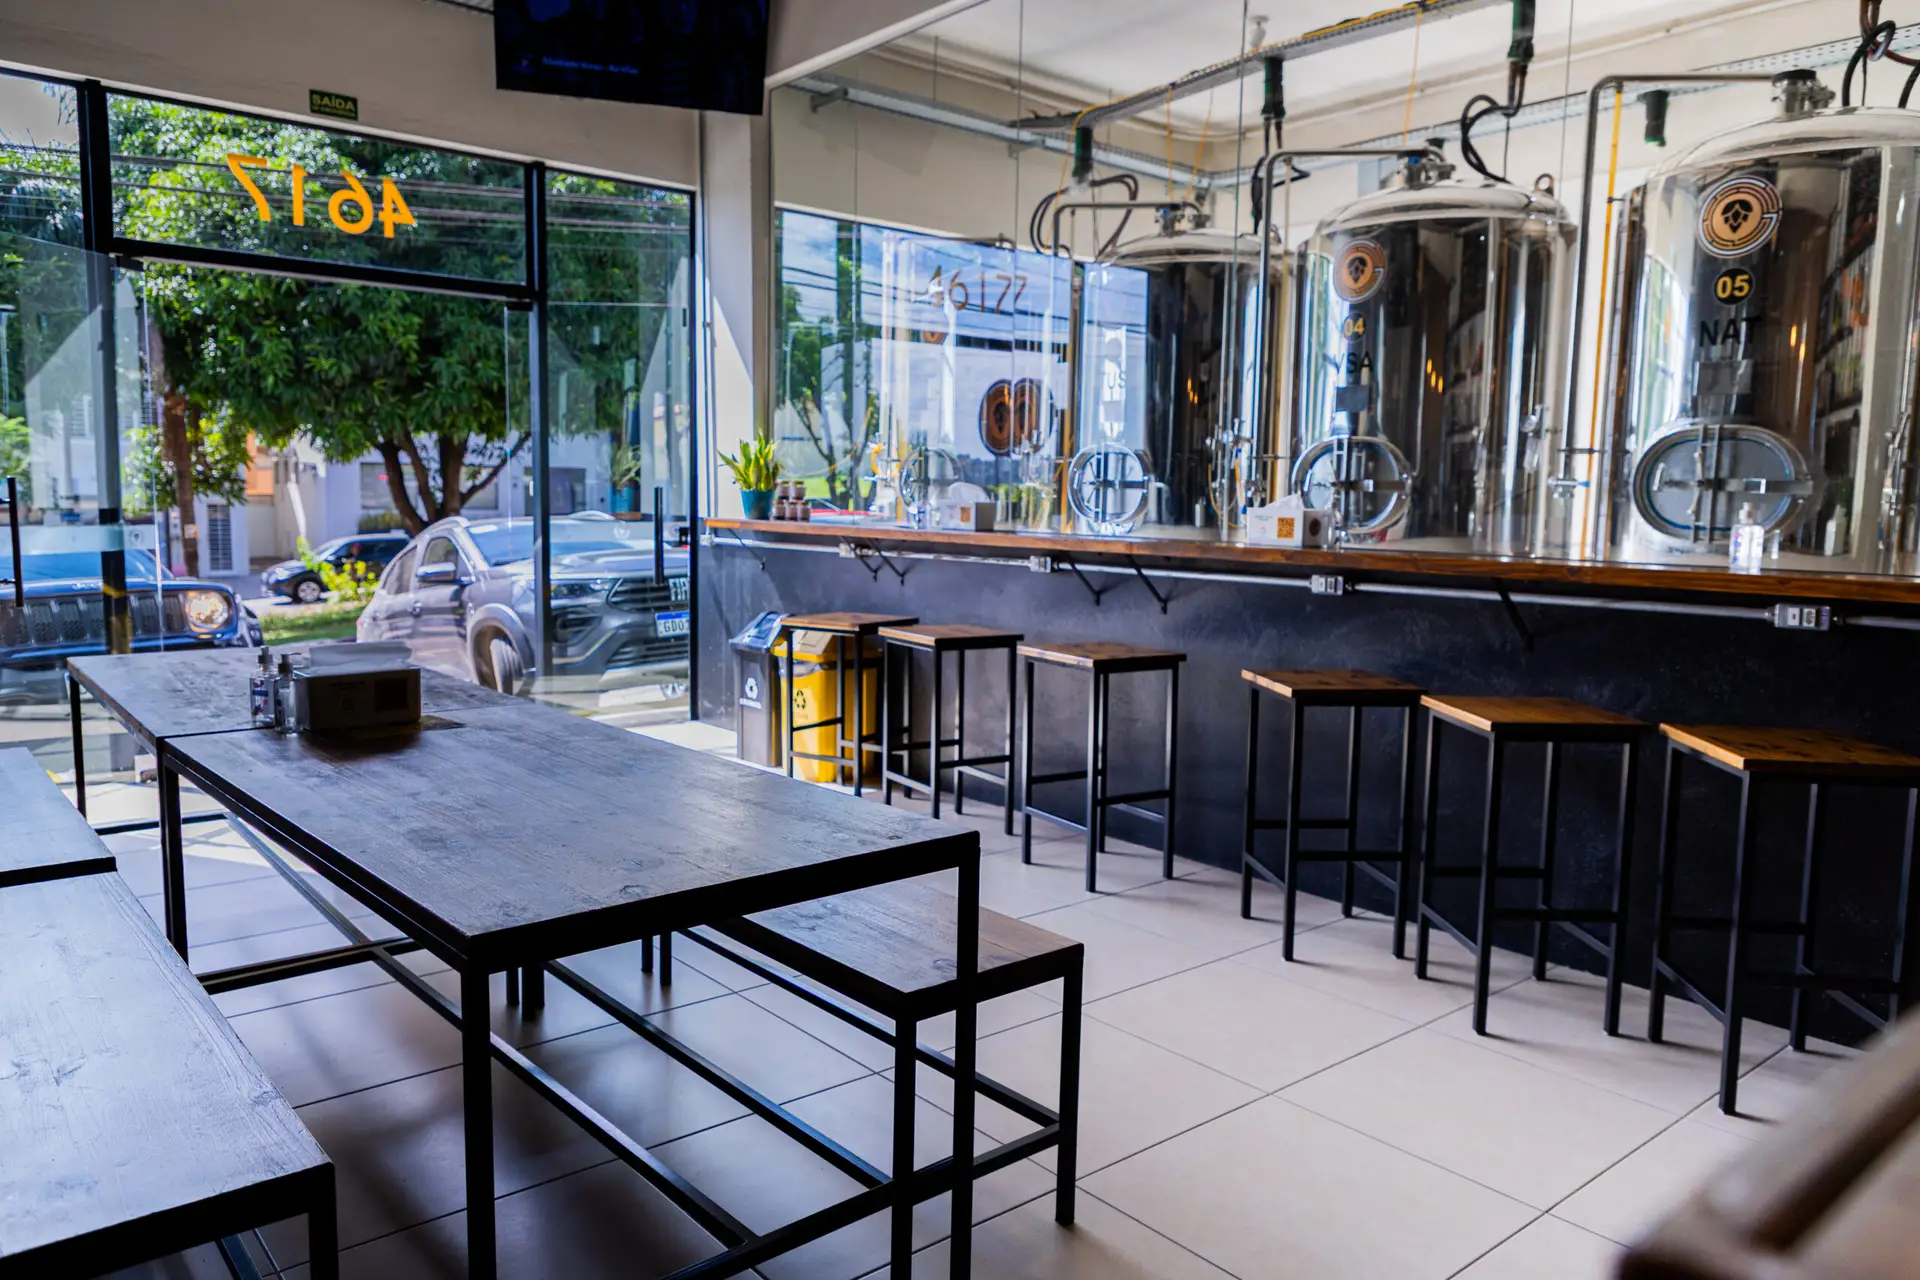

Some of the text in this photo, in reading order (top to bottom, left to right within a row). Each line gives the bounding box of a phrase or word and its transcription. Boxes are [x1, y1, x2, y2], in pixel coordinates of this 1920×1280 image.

[1716, 274, 1750, 298] 05
[1343, 317, 1366, 337] 04
[1699, 315, 1763, 347] NAT
